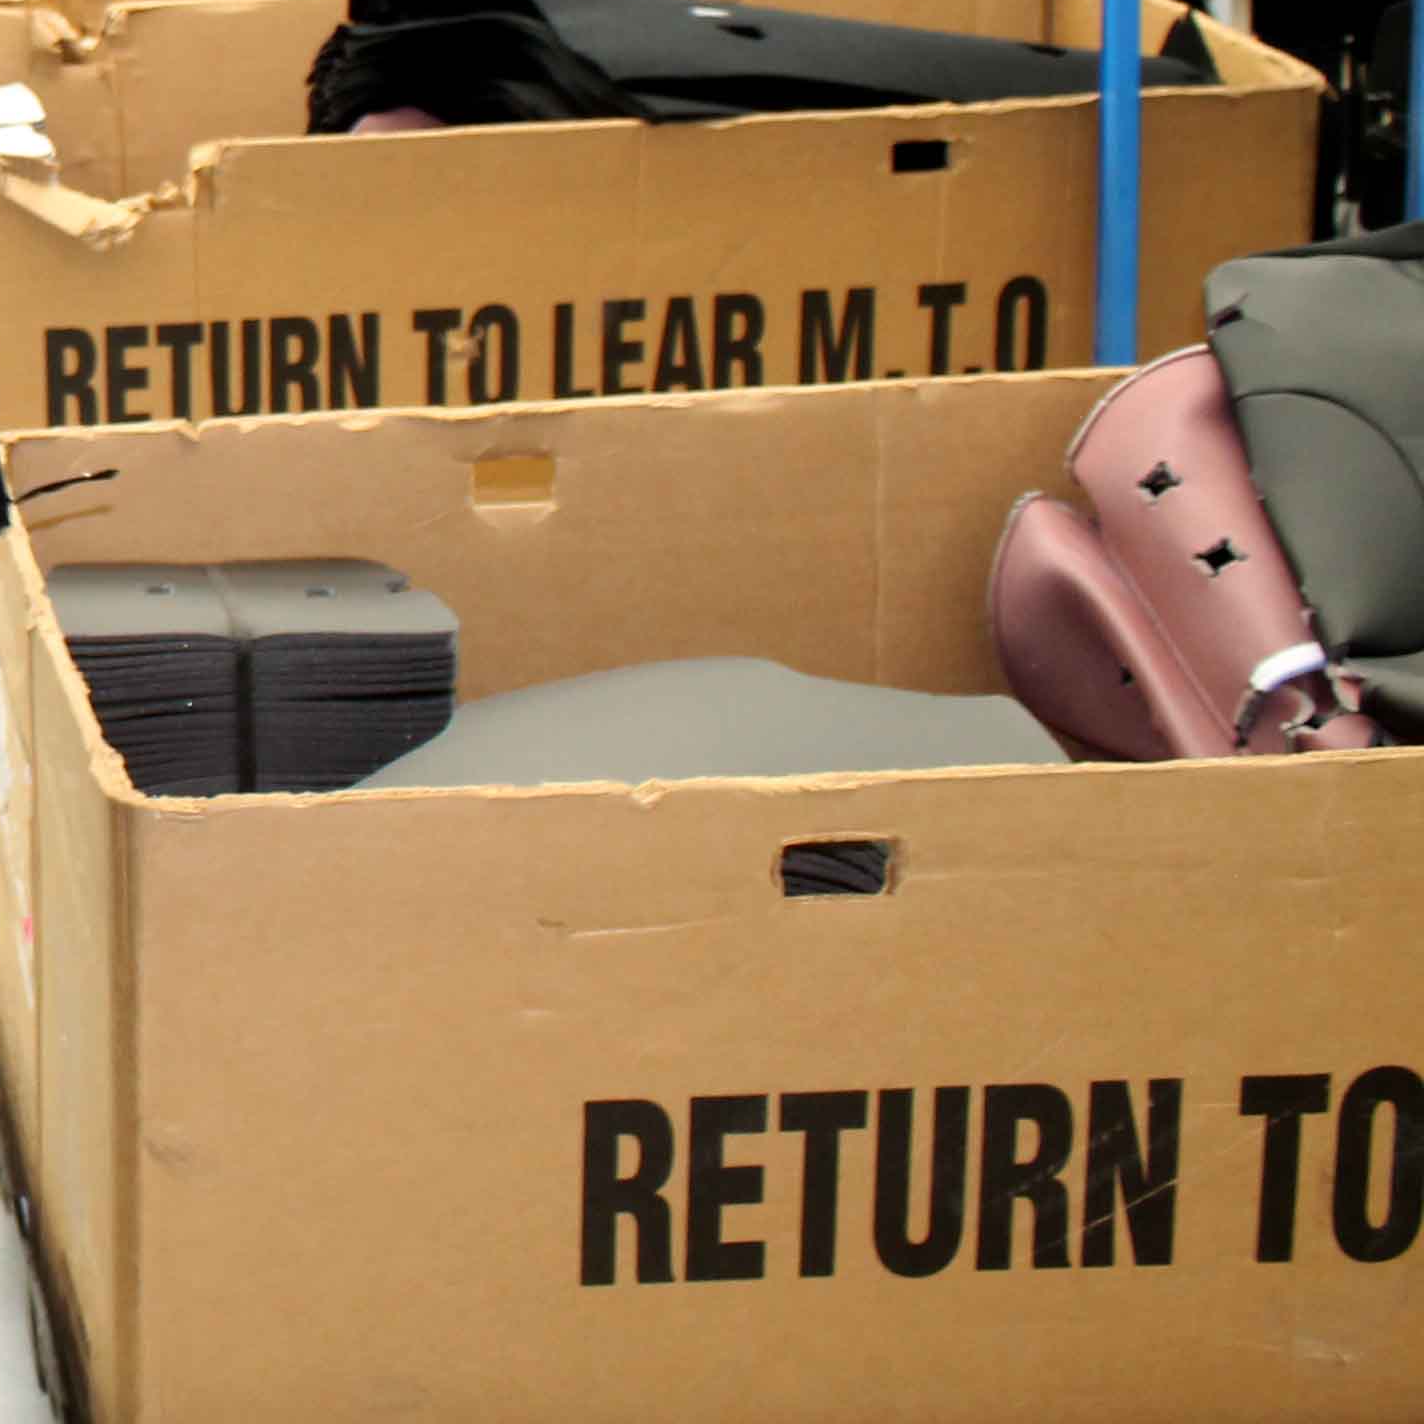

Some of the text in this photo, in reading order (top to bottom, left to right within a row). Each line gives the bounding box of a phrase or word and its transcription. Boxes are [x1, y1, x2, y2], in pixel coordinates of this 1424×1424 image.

[45, 313, 380, 426] RETURN
[411, 303, 519, 407] TO
[552, 293, 765, 400] LEAR
[579, 1065, 1424, 1287] RETURN TO
